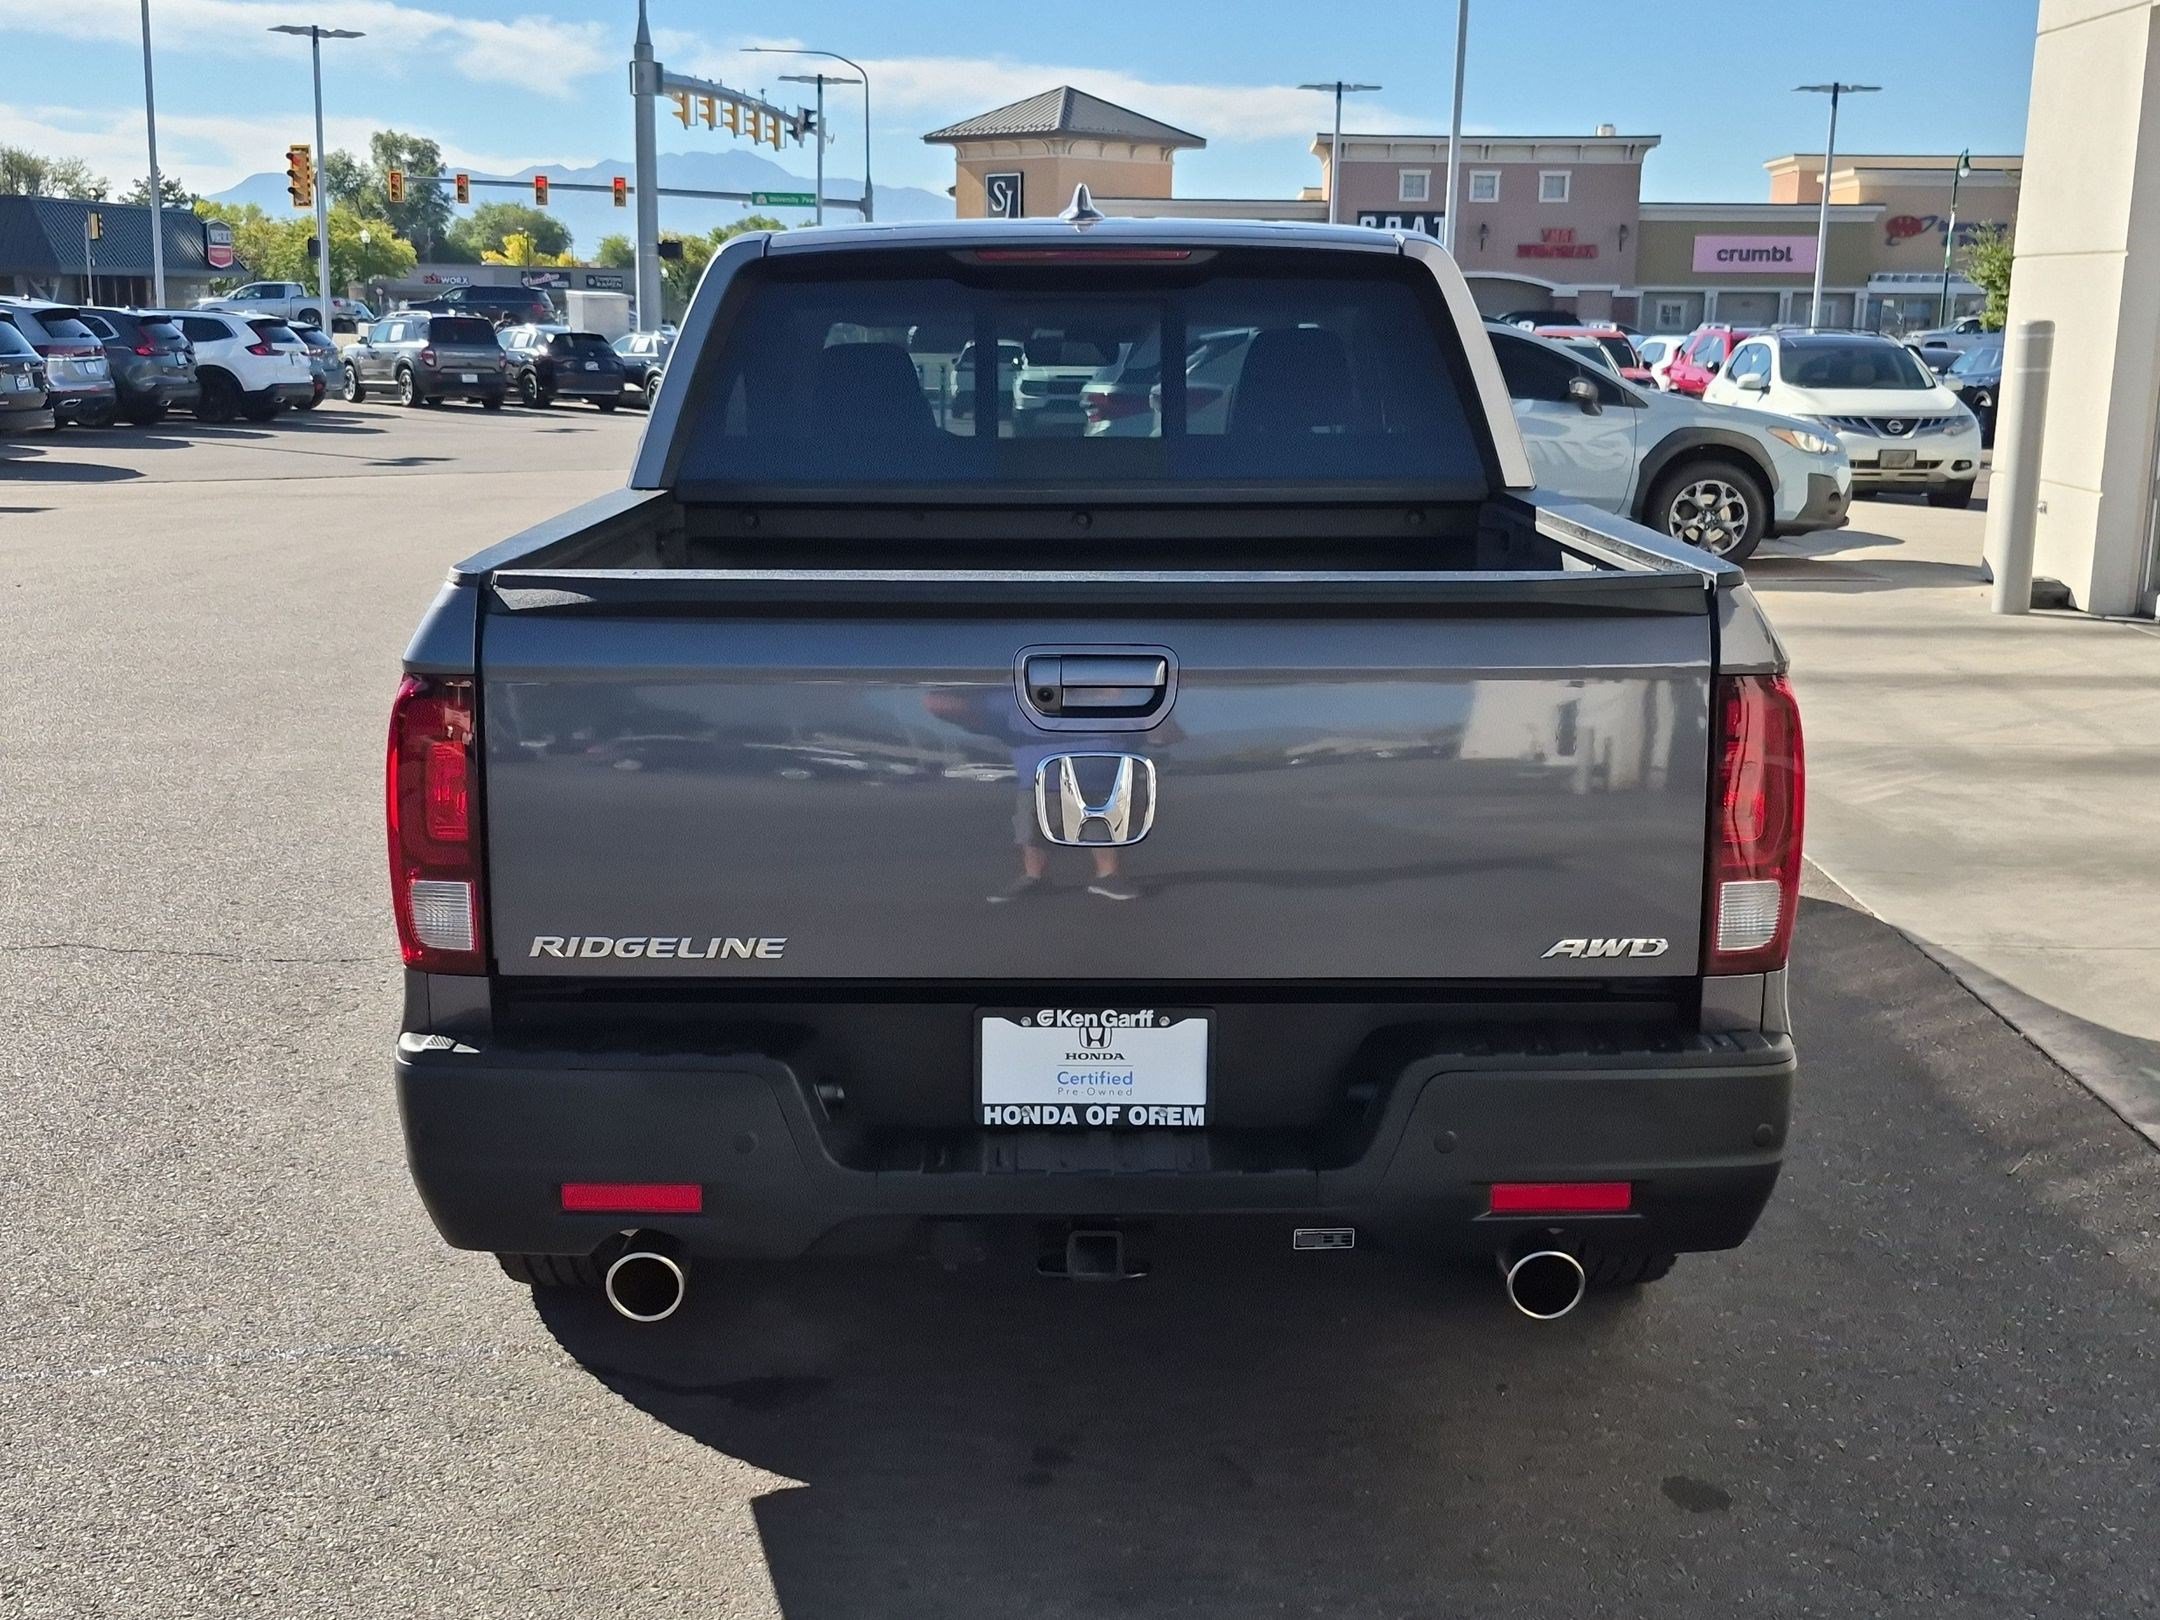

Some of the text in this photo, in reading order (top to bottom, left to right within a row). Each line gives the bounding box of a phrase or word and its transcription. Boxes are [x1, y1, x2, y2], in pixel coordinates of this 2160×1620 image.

[1717, 246, 1793, 262] crumbl
[528, 936, 788, 959] RIDGELINE
[1540, 938, 1669, 959] AWD
[1057, 1010, 1153, 1028] Ken Garff
[1057, 1071, 1133, 1085] Certified
[1058, 1087, 1132, 1096] Pre-Owned
[984, 1106, 1205, 1126] HONDA OF OREM
